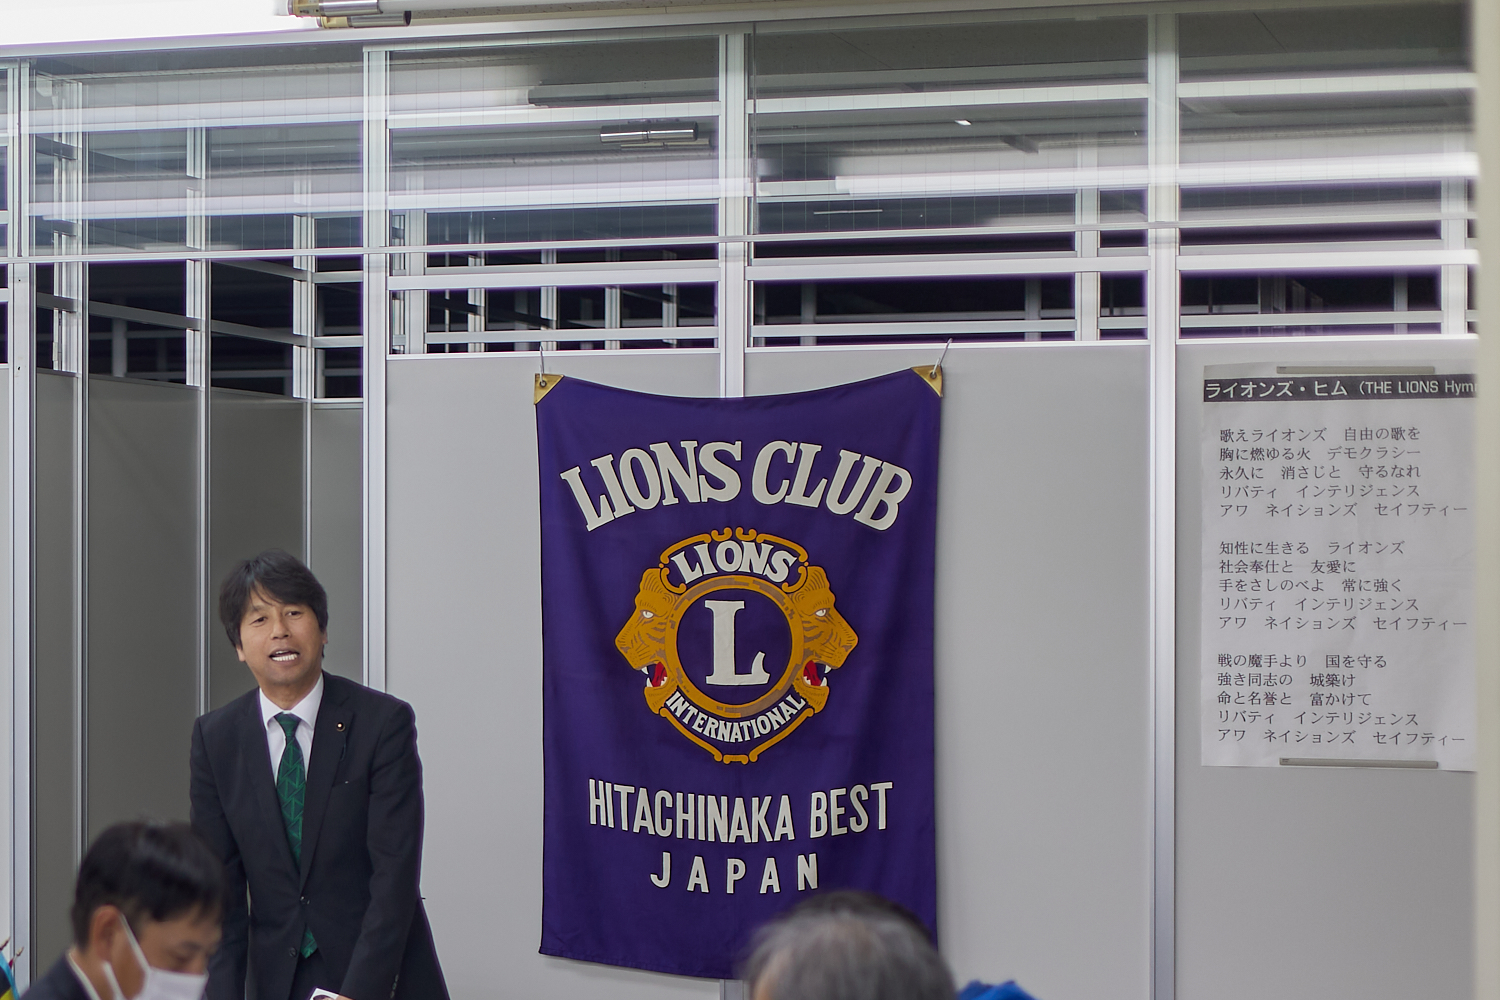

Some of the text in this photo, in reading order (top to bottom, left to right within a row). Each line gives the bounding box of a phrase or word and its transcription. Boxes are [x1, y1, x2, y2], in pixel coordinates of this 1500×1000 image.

[1205, 380, 1348, 398] ライオンズ・ヒム
[1398, 380, 1438, 394] LIONS
[1220, 427, 1420, 442] 歌えライオンズ 自由の歌を
[1220, 446, 1421, 461] 胸に燃ゆる火 デモクラシー
[1220, 465, 1421, 480] 永久に 消さじと 守るなれ
[560, 440, 913, 531] LIONS CLUB
[1221, 485, 1420, 498] リバティ インテリジェンス
[1220, 502, 1468, 517] アワ ネイションズ セイフティー
[1220, 541, 1404, 554] 知性に生きる ライオンズ
[671, 540, 796, 585] LIONS
[1219, 560, 1356, 574] 社会奉仕と 友愛に
[1219, 578, 1402, 592] 手をさしのべよ 常に強く
[1220, 598, 1419, 611] リバティ インテリジェンス
[1219, 616, 1467, 630] アワ ネイションズ セイフティー
[705, 600, 770, 686] L
[1218, 654, 1387, 668] 戦の魔手より 国を守る
[1218, 674, 1356, 687] 強き同志の 城築け
[1218, 692, 1372, 706] 命と名誉と 富かけて
[665, 691, 806, 743] INTERNATIONAL
[1219, 710, 1418, 726] リバティ インテリジェンス
[1218, 728, 1465, 746] アワ ネイションズ セイフティー
[588, 778, 894, 843] HITACHINAKA BEST
[650, 852, 818, 894] JAPAN
